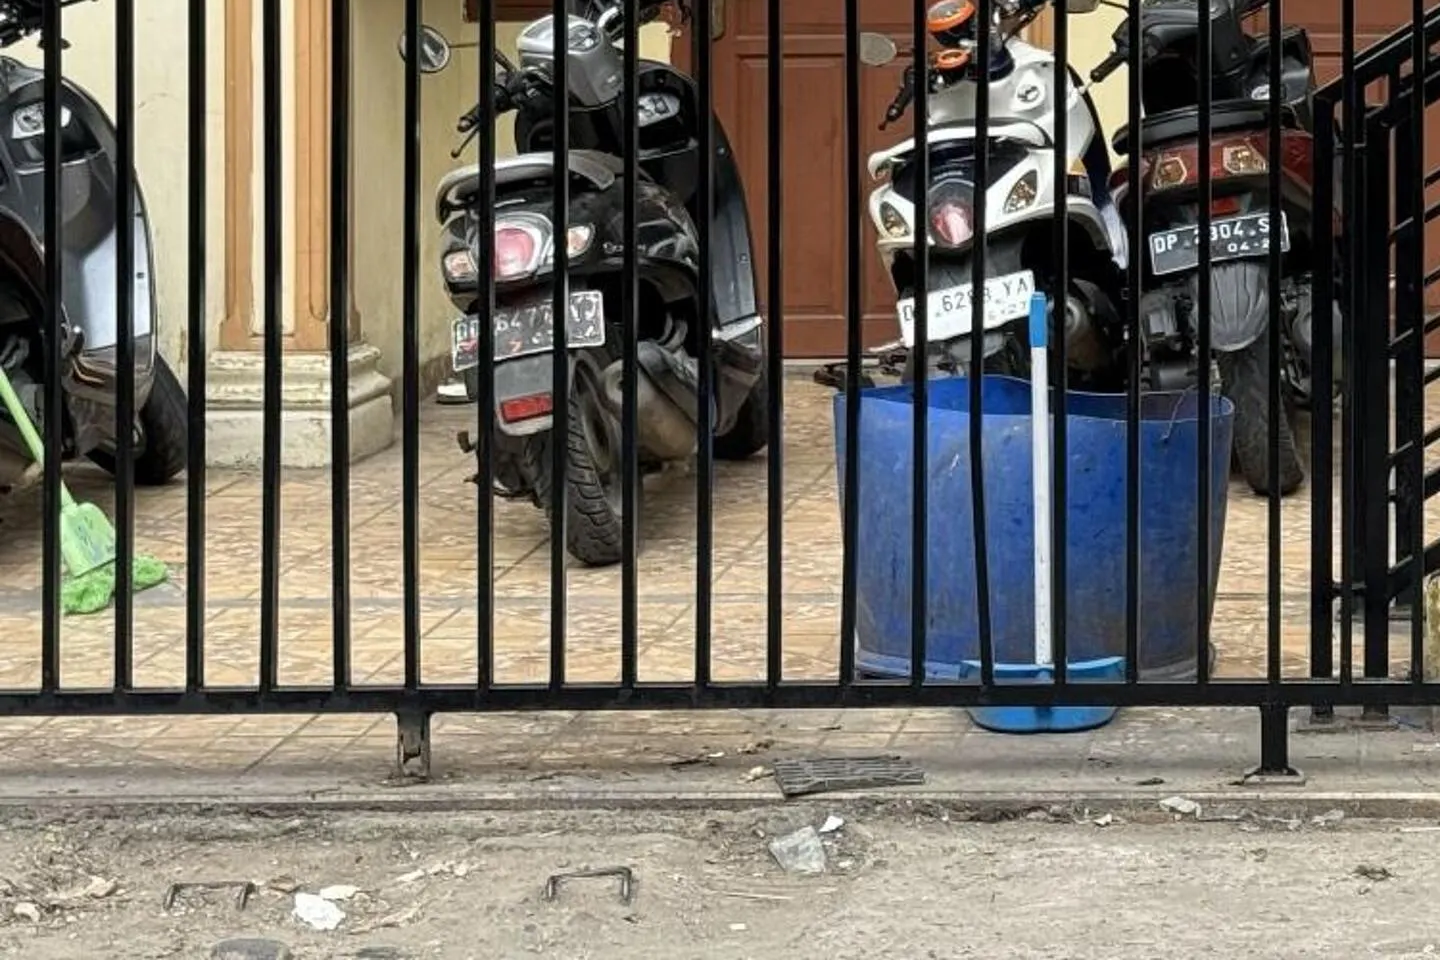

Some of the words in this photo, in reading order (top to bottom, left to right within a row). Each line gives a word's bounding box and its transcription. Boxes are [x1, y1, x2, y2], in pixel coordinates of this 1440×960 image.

[1153, 234, 1178, 254] DP
[1194, 221, 1244, 245] 304
[1227, 238, 1271, 253] 04-2
[1002, 277, 1029, 298] YA
